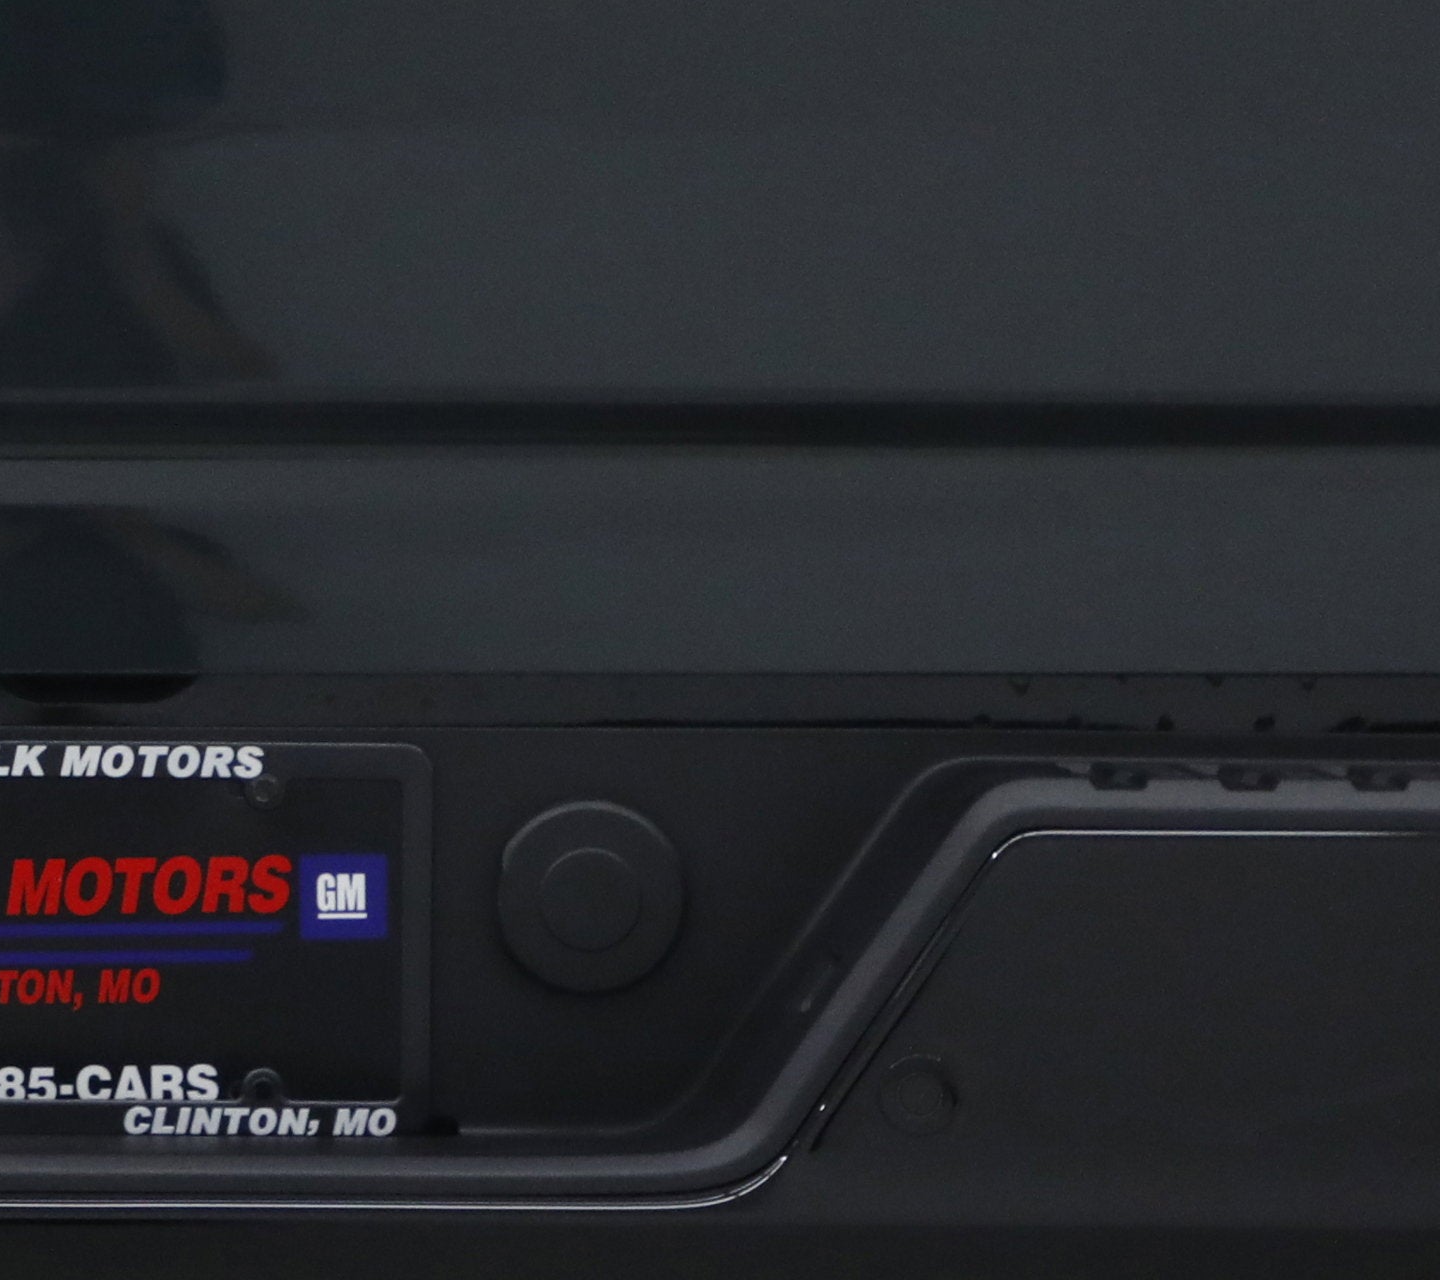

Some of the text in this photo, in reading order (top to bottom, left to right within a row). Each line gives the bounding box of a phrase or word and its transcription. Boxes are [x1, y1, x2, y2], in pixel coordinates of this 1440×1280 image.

[60, 742, 266, 779] MOTORS
[5, 853, 293, 917] MOTORS
[316, 872, 366, 912] GM
[97, 967, 161, 1004] MO
[123, 1106, 397, 1137] CLINTON, MO
